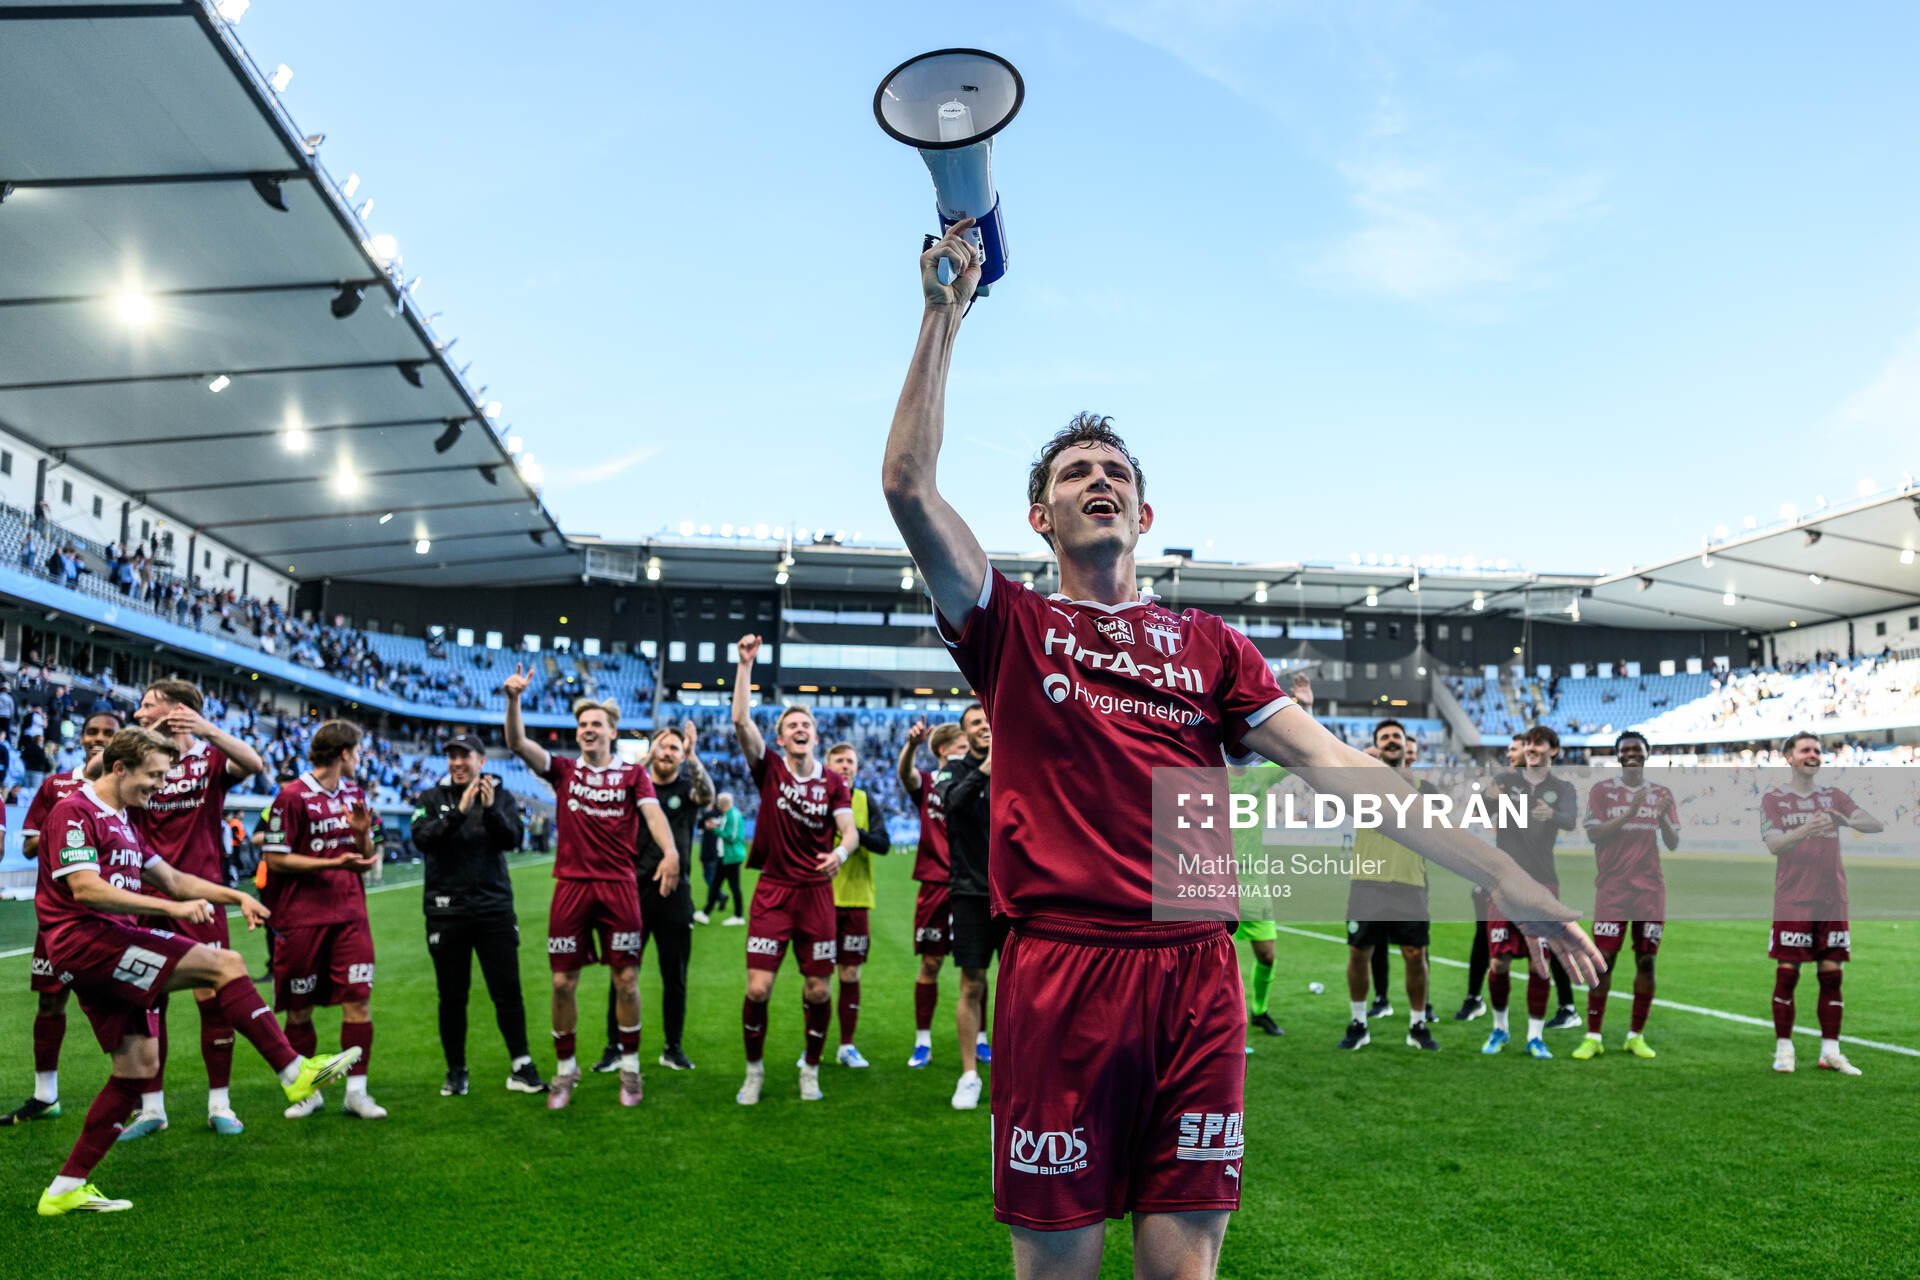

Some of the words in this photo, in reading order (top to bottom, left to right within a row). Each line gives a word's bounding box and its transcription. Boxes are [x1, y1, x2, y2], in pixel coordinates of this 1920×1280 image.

[1044, 628, 1204, 694] HITACHI
[1010, 1126, 1088, 1164] RYDS
[1039, 1160, 1088, 1175] BILGLAS
